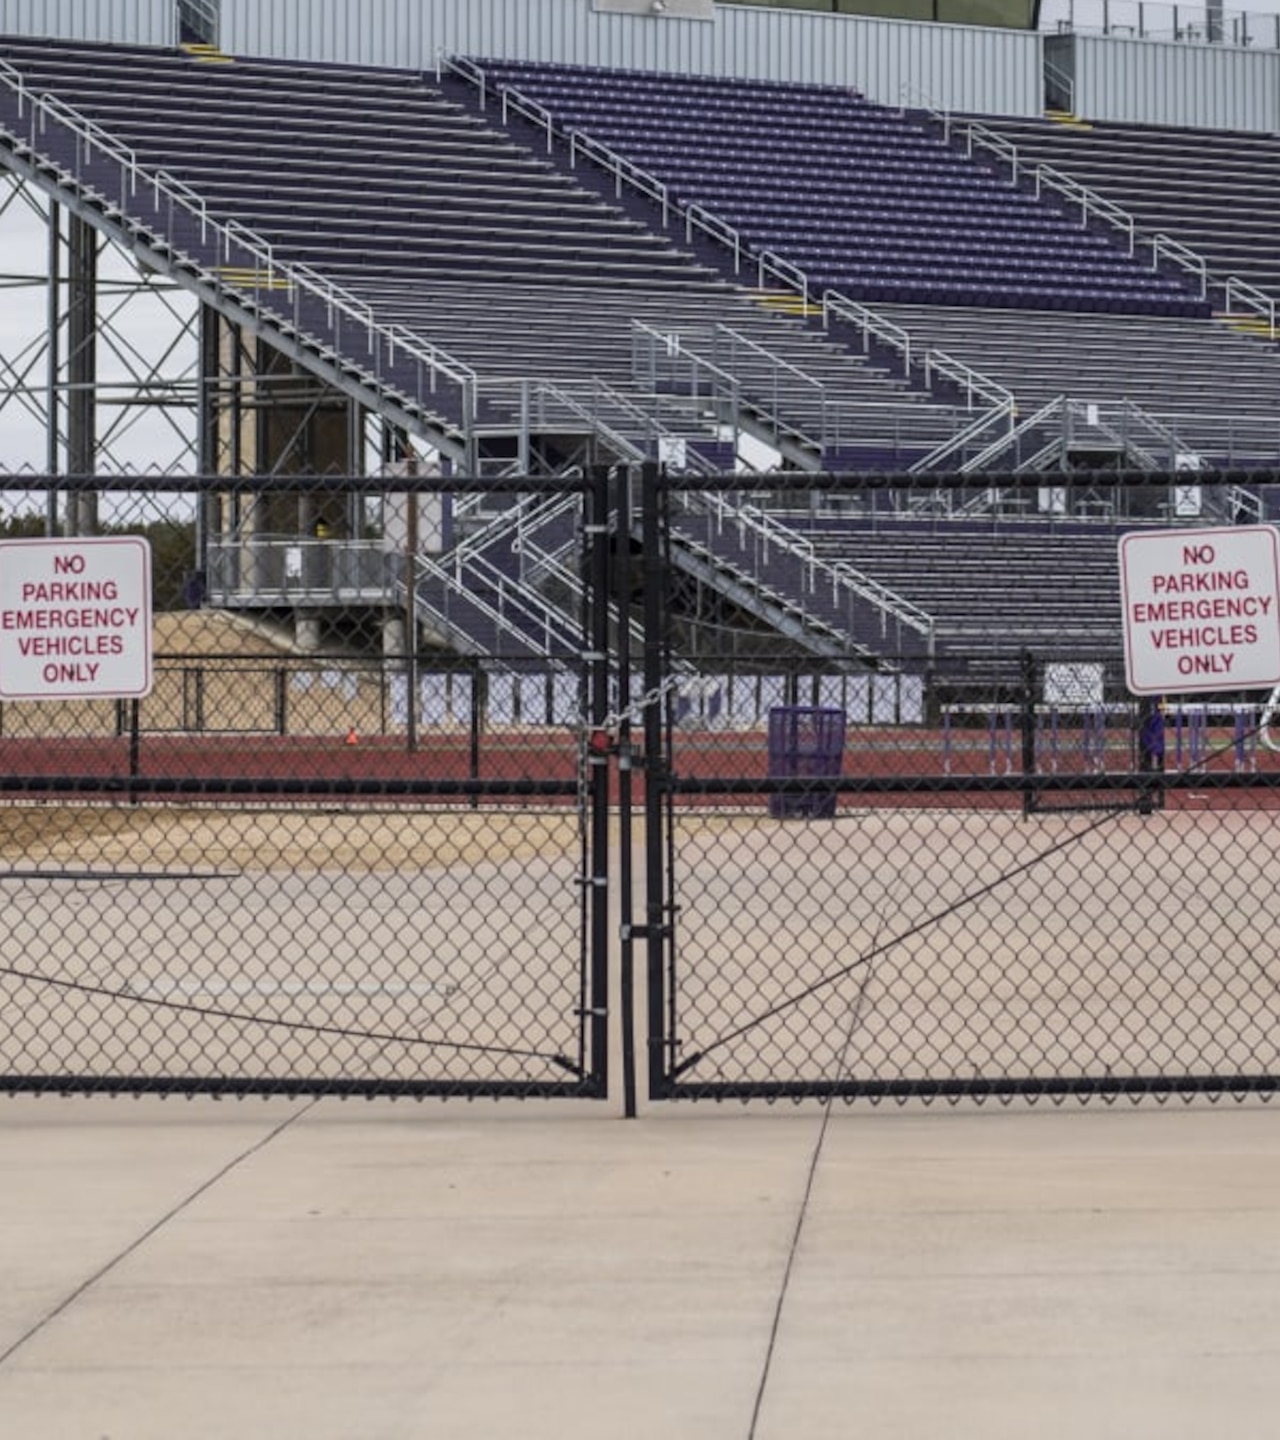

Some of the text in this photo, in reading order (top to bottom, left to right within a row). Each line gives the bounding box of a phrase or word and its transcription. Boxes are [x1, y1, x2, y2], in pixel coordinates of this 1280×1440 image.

[54, 555, 85, 574] NO
[1183, 545, 1215, 565] NO
[23, 582, 118, 602] PARKING
[1153, 570, 1249, 594] PARKING
[2, 608, 139, 630] EMERGENCY
[1133, 596, 1272, 623] EMERGENCY
[19, 635, 123, 656] VEHICLES
[1151, 625, 1258, 649] VEHICLES
[43, 663, 100, 683] ONLY
[1177, 653, 1235, 675] ONLY
